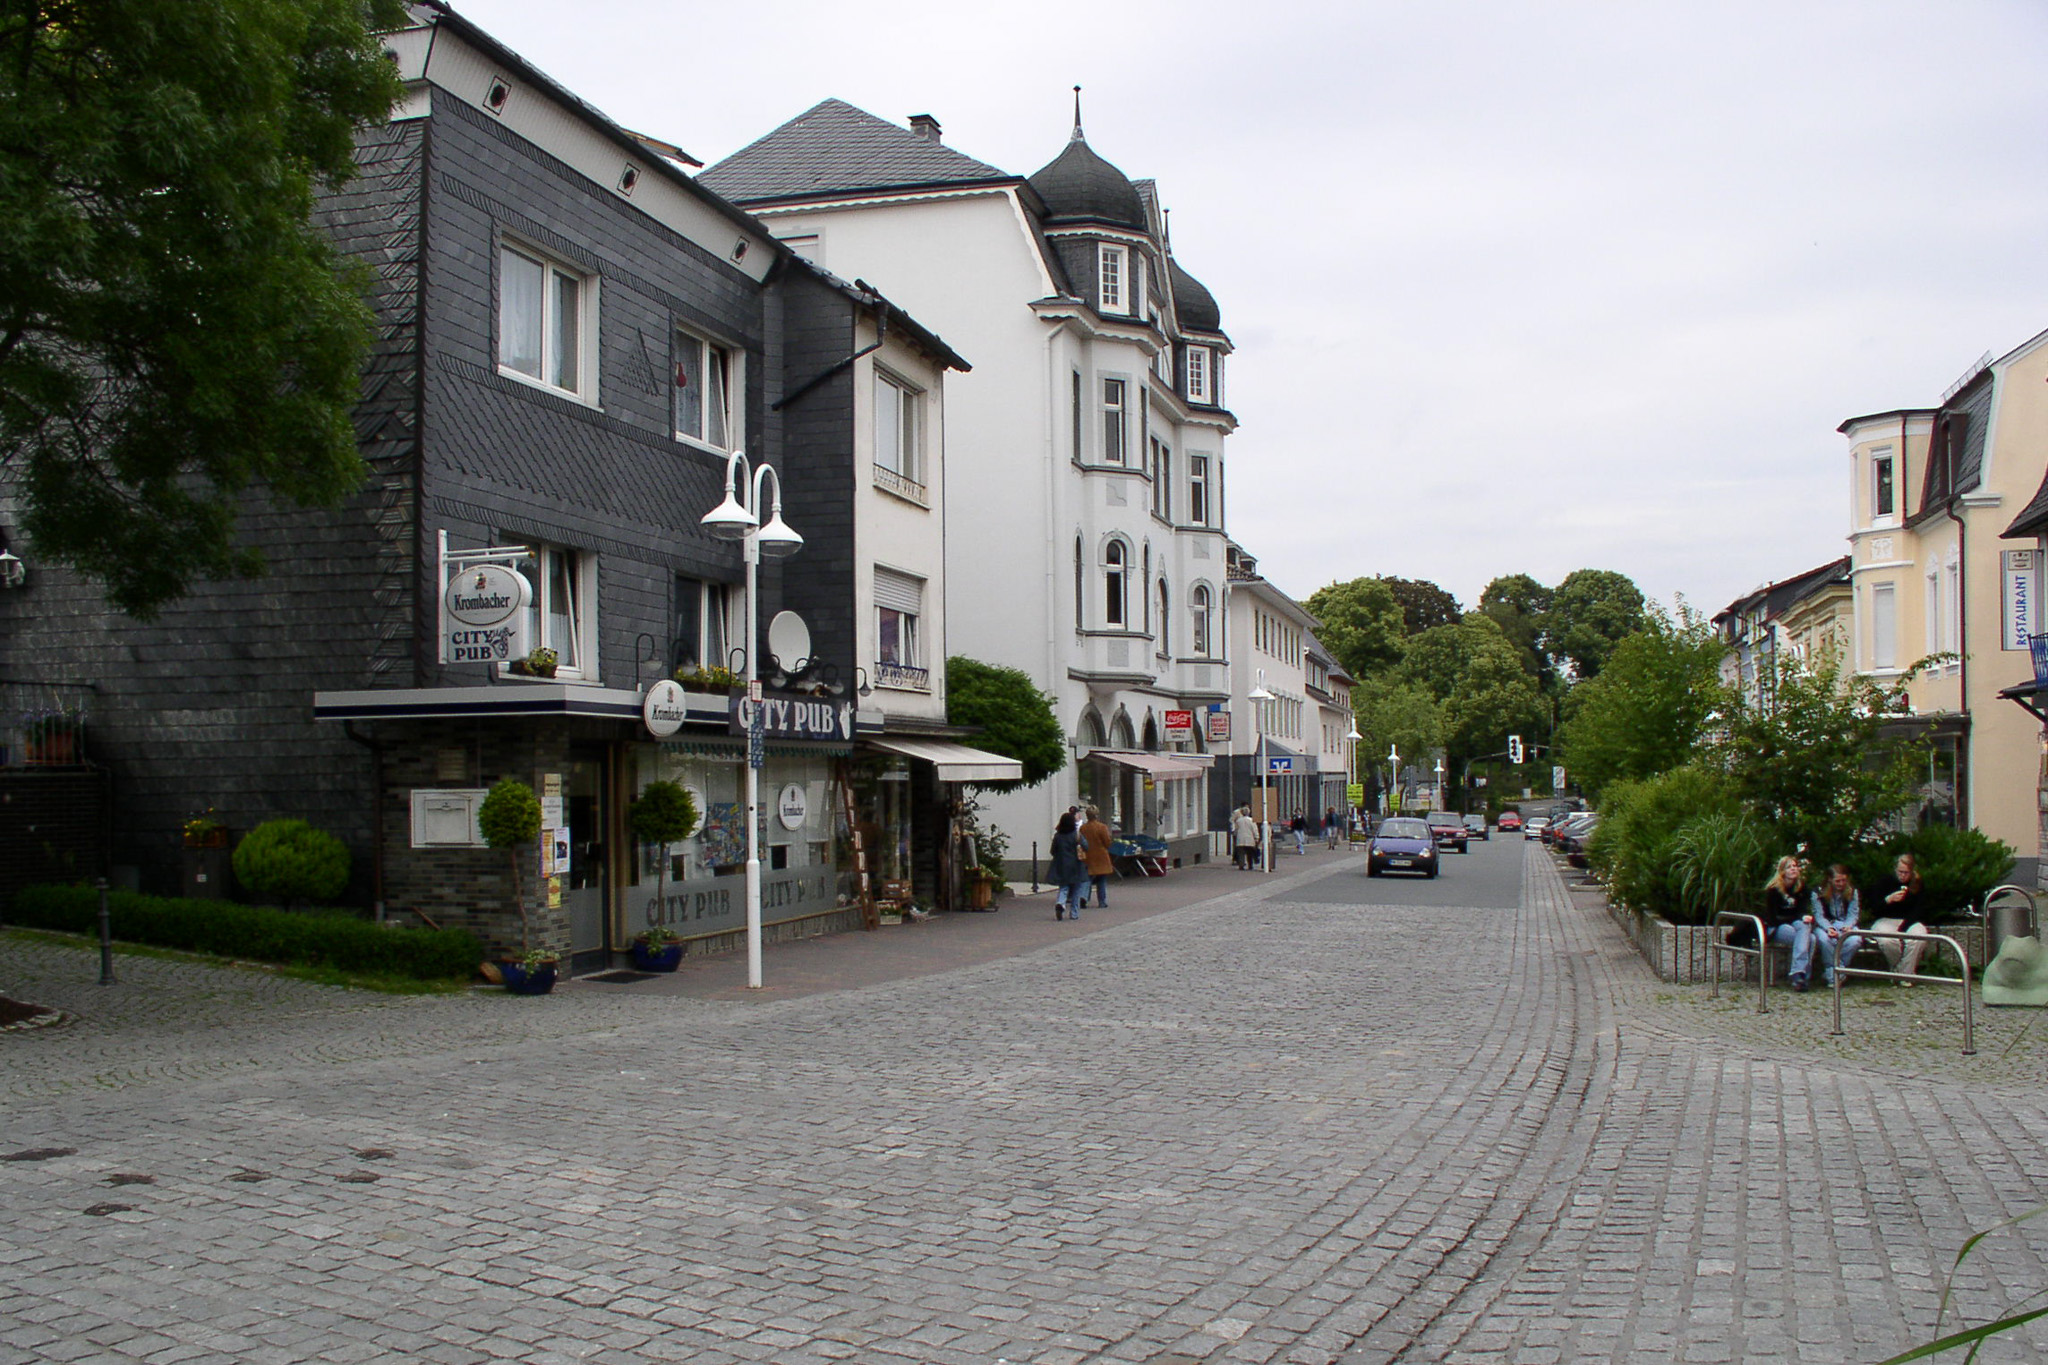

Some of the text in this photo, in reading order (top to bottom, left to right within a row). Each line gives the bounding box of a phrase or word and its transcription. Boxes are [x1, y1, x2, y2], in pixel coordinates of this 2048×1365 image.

[454, 592, 511, 611] Krombacher
[2014, 575, 2027, 646] RESTAURANT
[452, 630, 493, 645] CITY
[455, 646, 492, 661] PUB
[652, 704, 684, 722] Krombacher
[738, 697, 789, 731] CTY
[794, 702, 834, 733] PUB
[696, 889, 731, 919] PUB
